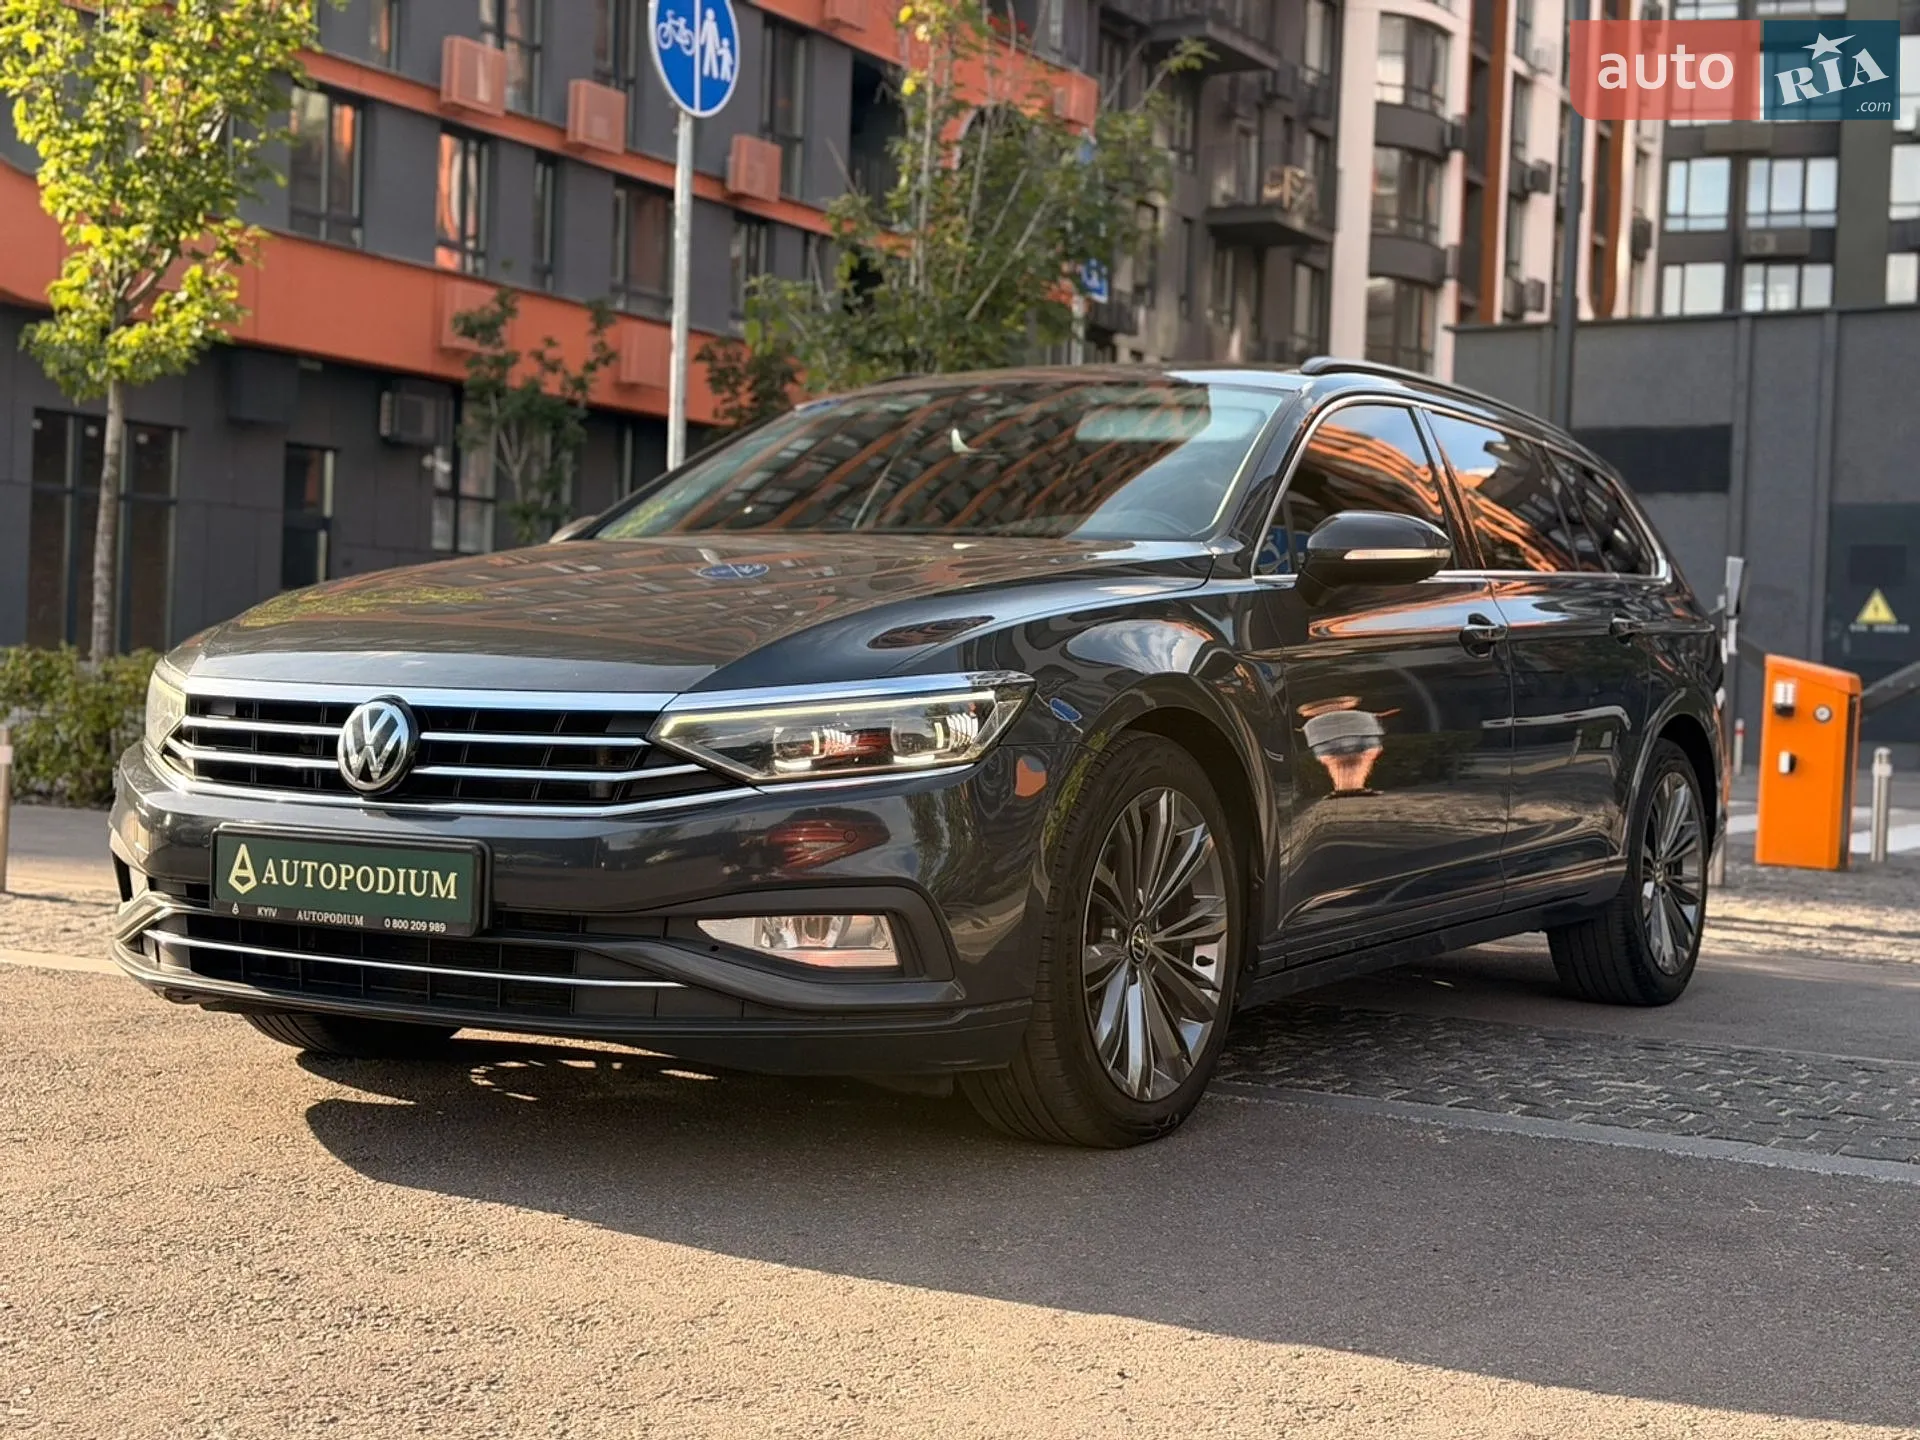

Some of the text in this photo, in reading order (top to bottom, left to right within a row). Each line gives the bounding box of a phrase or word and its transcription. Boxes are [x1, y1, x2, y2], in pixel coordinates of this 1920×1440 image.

[261, 858, 459, 900] AUTOPODIUM
[256, 906, 447, 933] KYIV AUTOPODIUM 0 800 209 989
